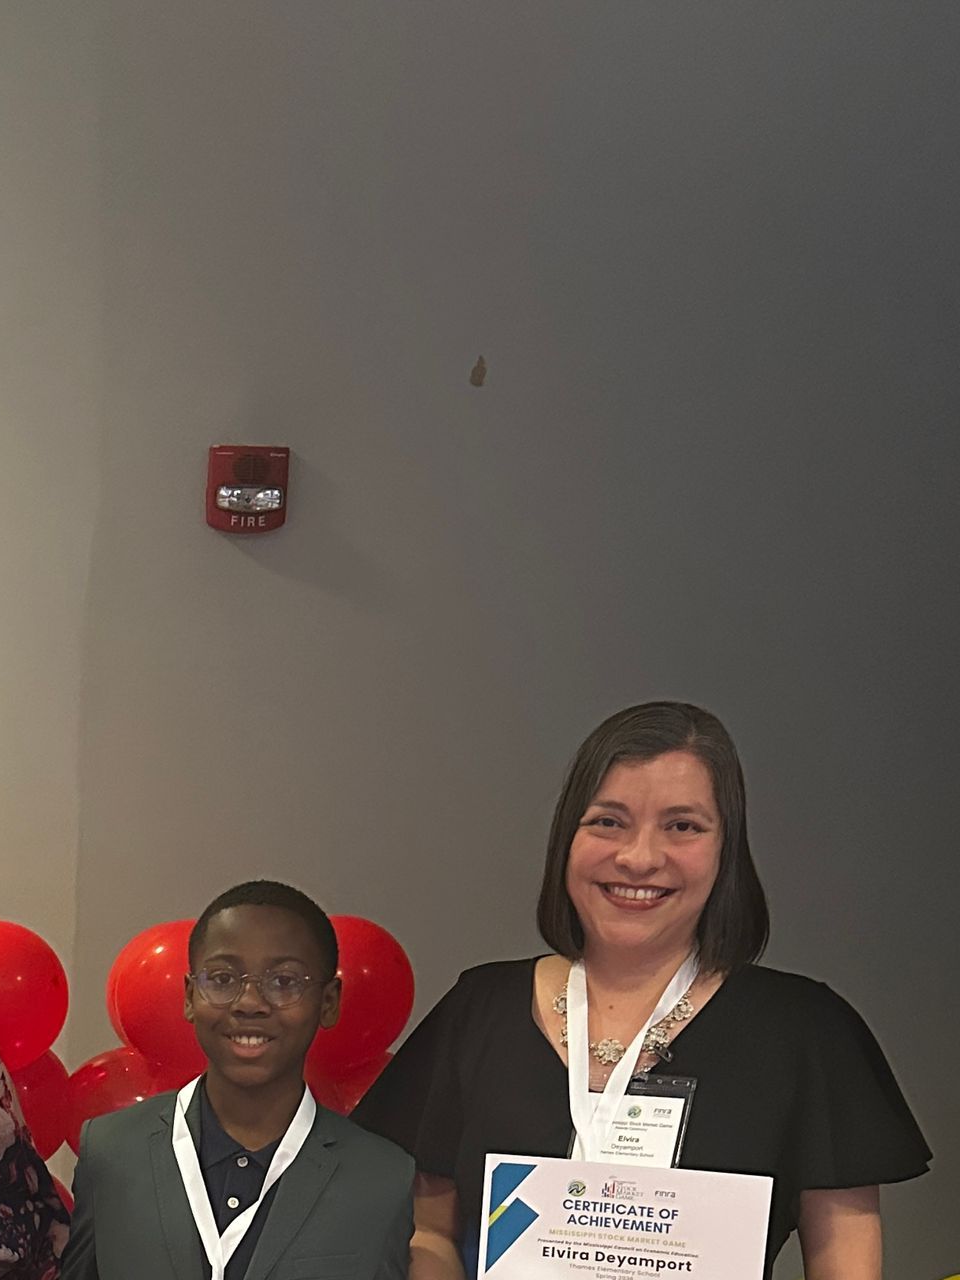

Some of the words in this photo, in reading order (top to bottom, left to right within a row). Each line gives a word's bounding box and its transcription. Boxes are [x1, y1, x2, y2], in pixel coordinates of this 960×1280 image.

[231, 516, 266, 526] FIRE
[618, 1135, 640, 1143] Elvira
[563, 1199, 654, 1218] CERTIFICATE
[659, 1209, 679, 1220] OF
[567, 1214, 672, 1234] ACHIEVEMENT
[549, 1229, 596, 1238] MISSISSIPPI
[598, 1233, 625, 1241] STOCK
[627, 1236, 660, 1245] MARKET
[663, 1240, 686, 1248] GAME
[542, 1246, 589, 1260] Elvira
[595, 1251, 692, 1271] Deyamport
[597, 1266, 635, 1276] Elementary
